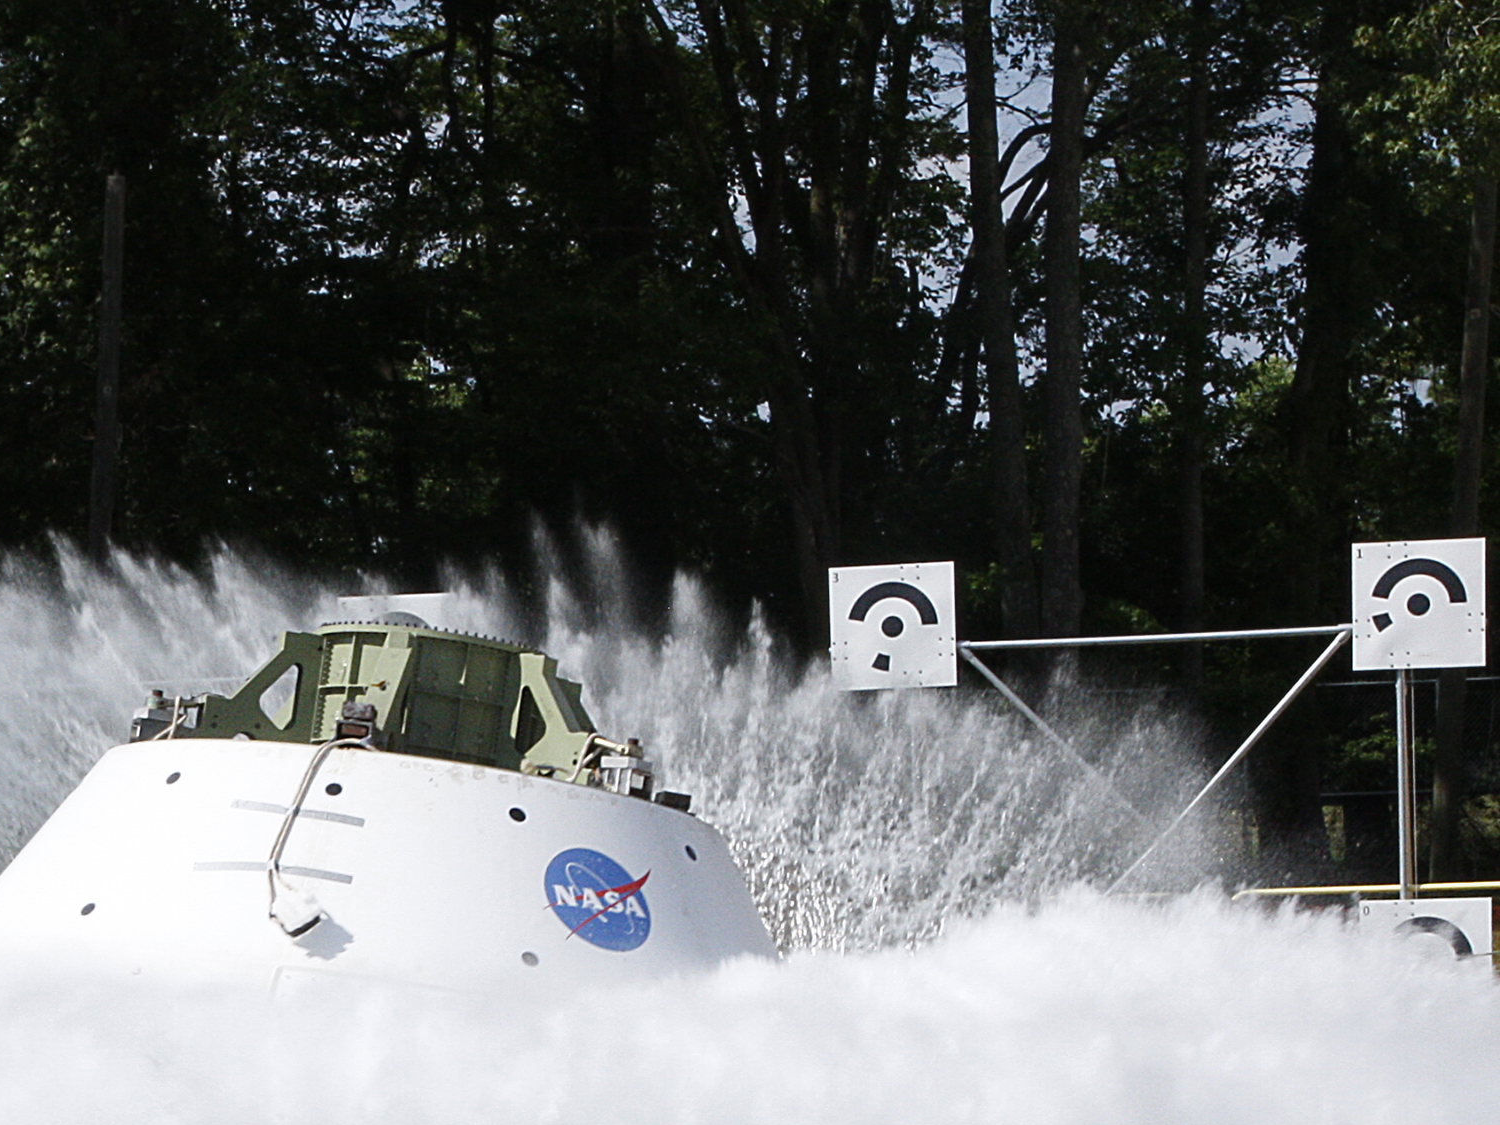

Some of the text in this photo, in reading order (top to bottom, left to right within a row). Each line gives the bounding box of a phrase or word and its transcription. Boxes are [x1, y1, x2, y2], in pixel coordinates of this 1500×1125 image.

[1357, 548, 1363, 559] 1
[832, 572, 839, 583] 3
[552, 884, 647, 918] NASA
